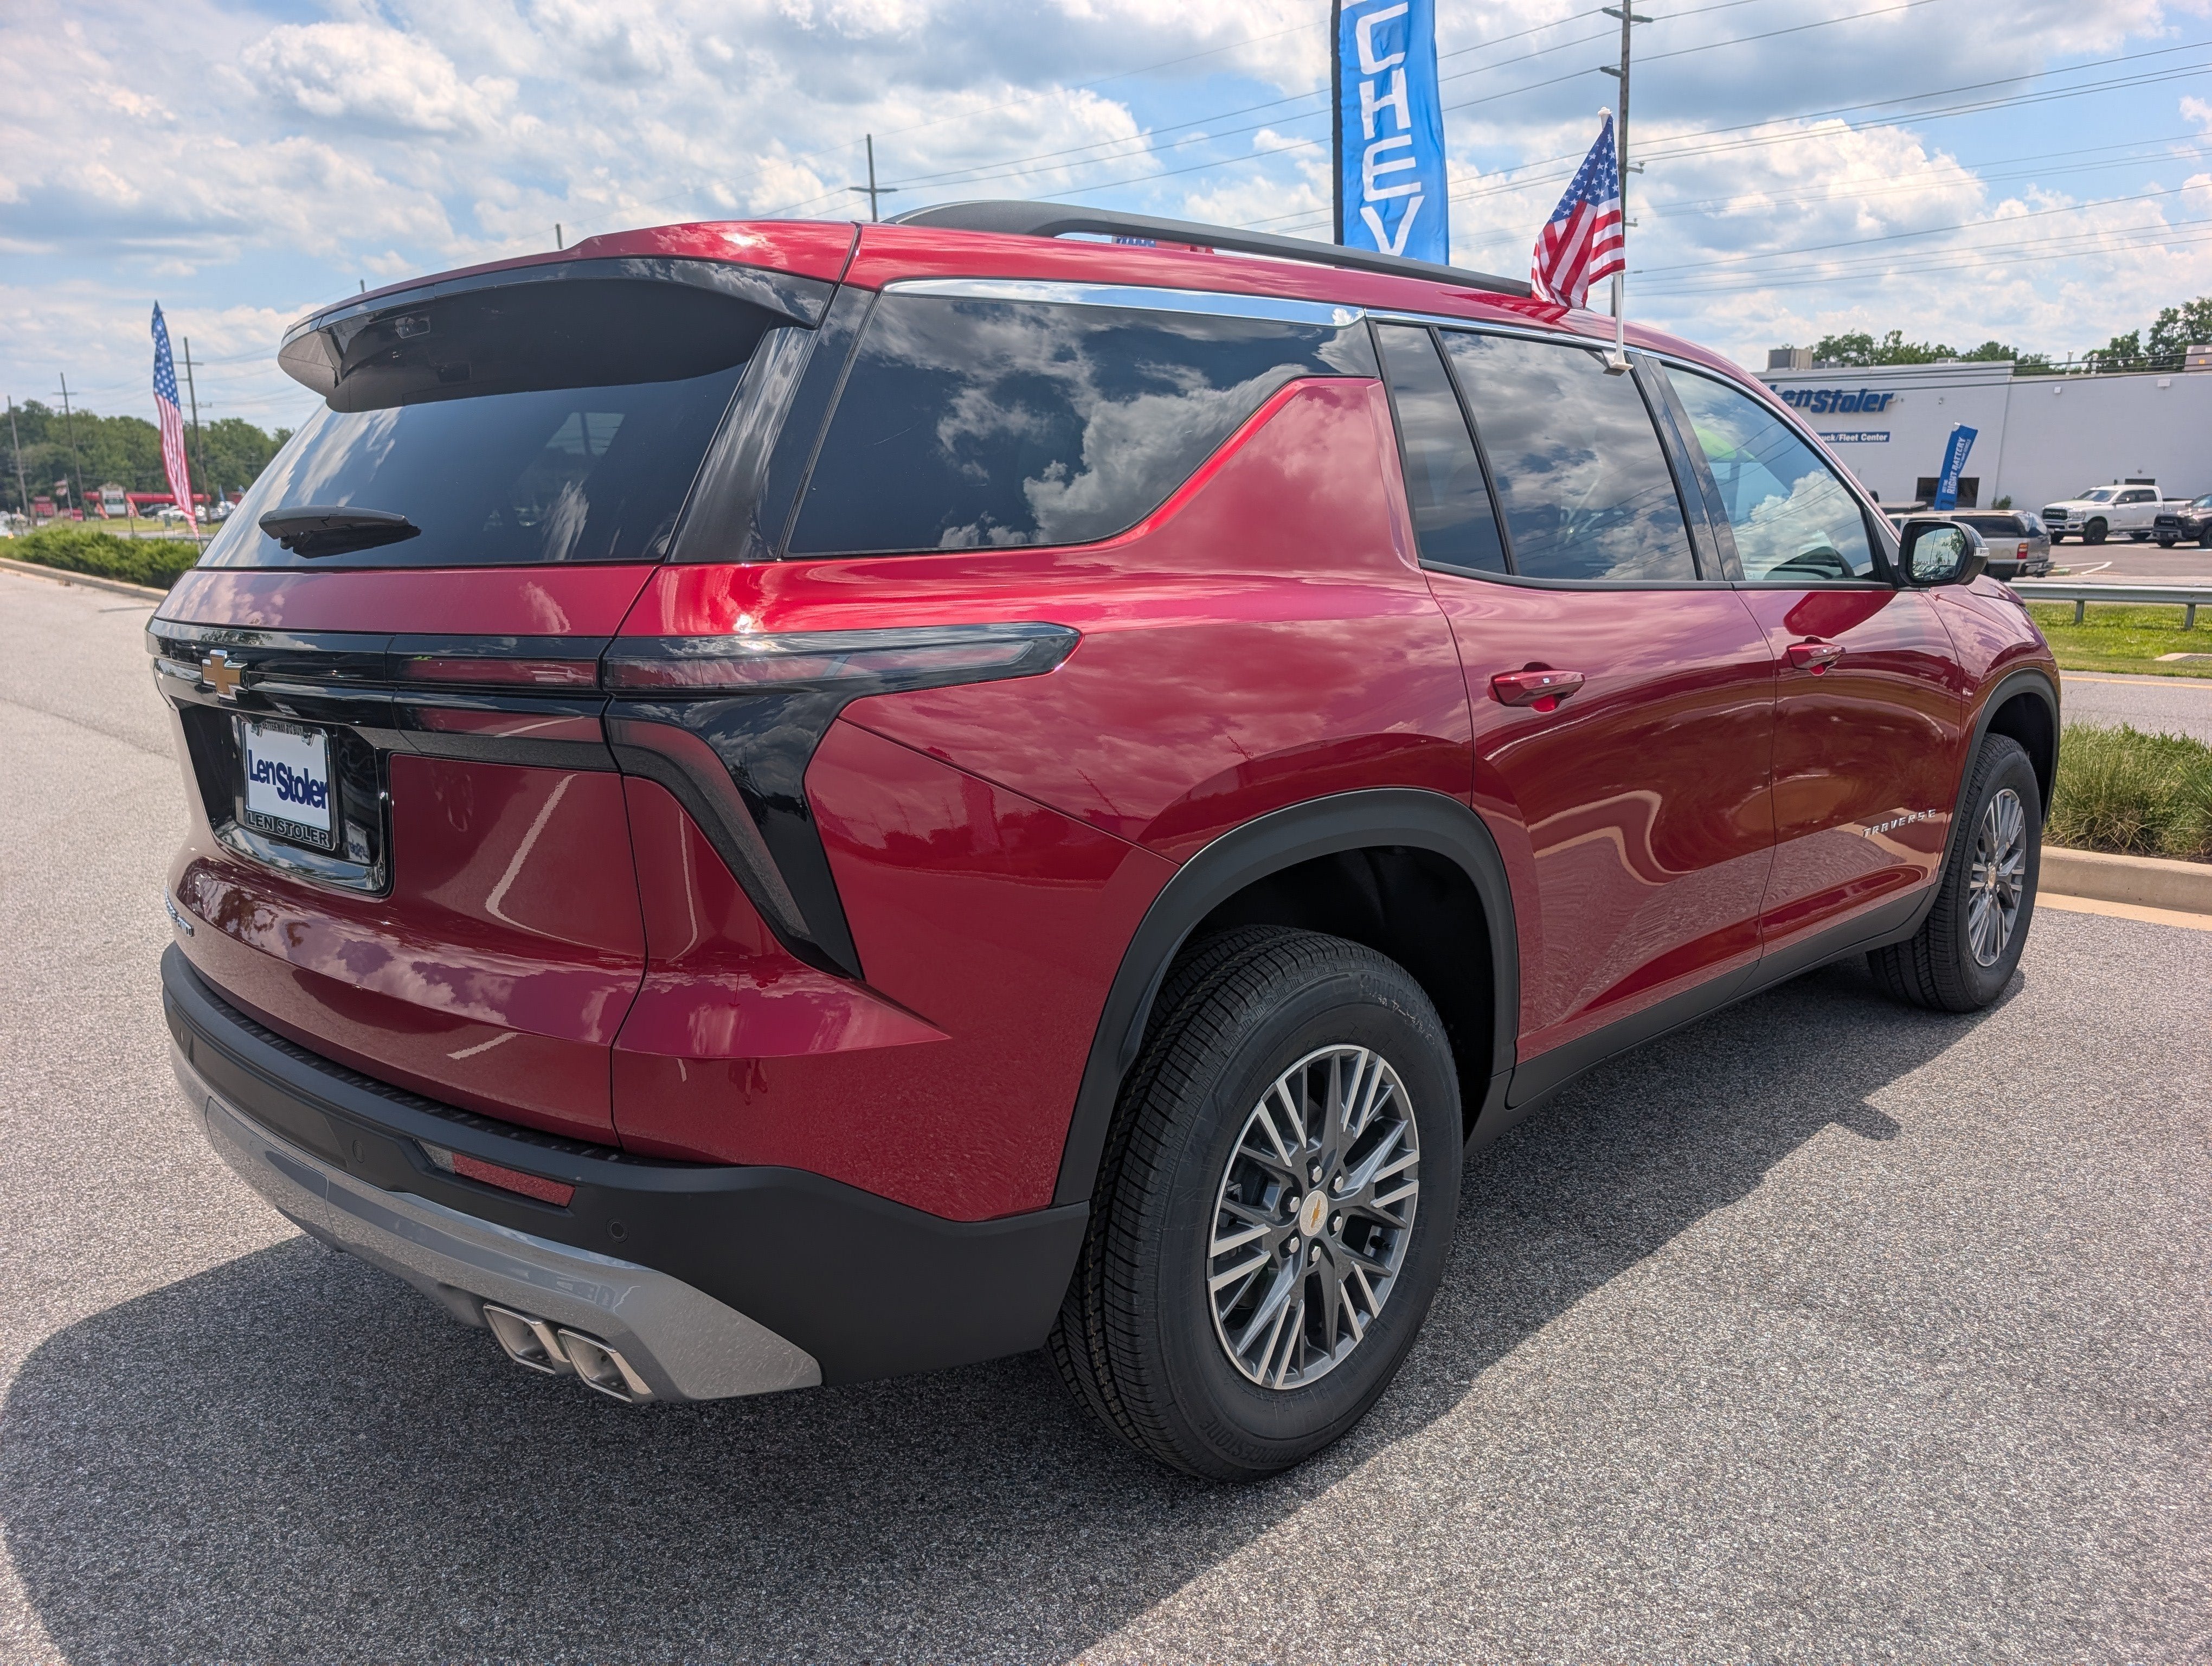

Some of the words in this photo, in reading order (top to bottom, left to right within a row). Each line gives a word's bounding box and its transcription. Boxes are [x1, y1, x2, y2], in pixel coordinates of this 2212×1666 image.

[1355, 2, 1425, 257] CHEV
[1769, 385, 1894, 414] enStoler
[1821, 433, 1859, 442] uck/Fleet
[1861, 433, 1888, 442] Center
[1951, 436, 1966, 471] BATTERY
[247, 811, 274, 831] LEN
[276, 819, 330, 848] STOLER
[1862, 809, 1937, 838] TRAVERSE
